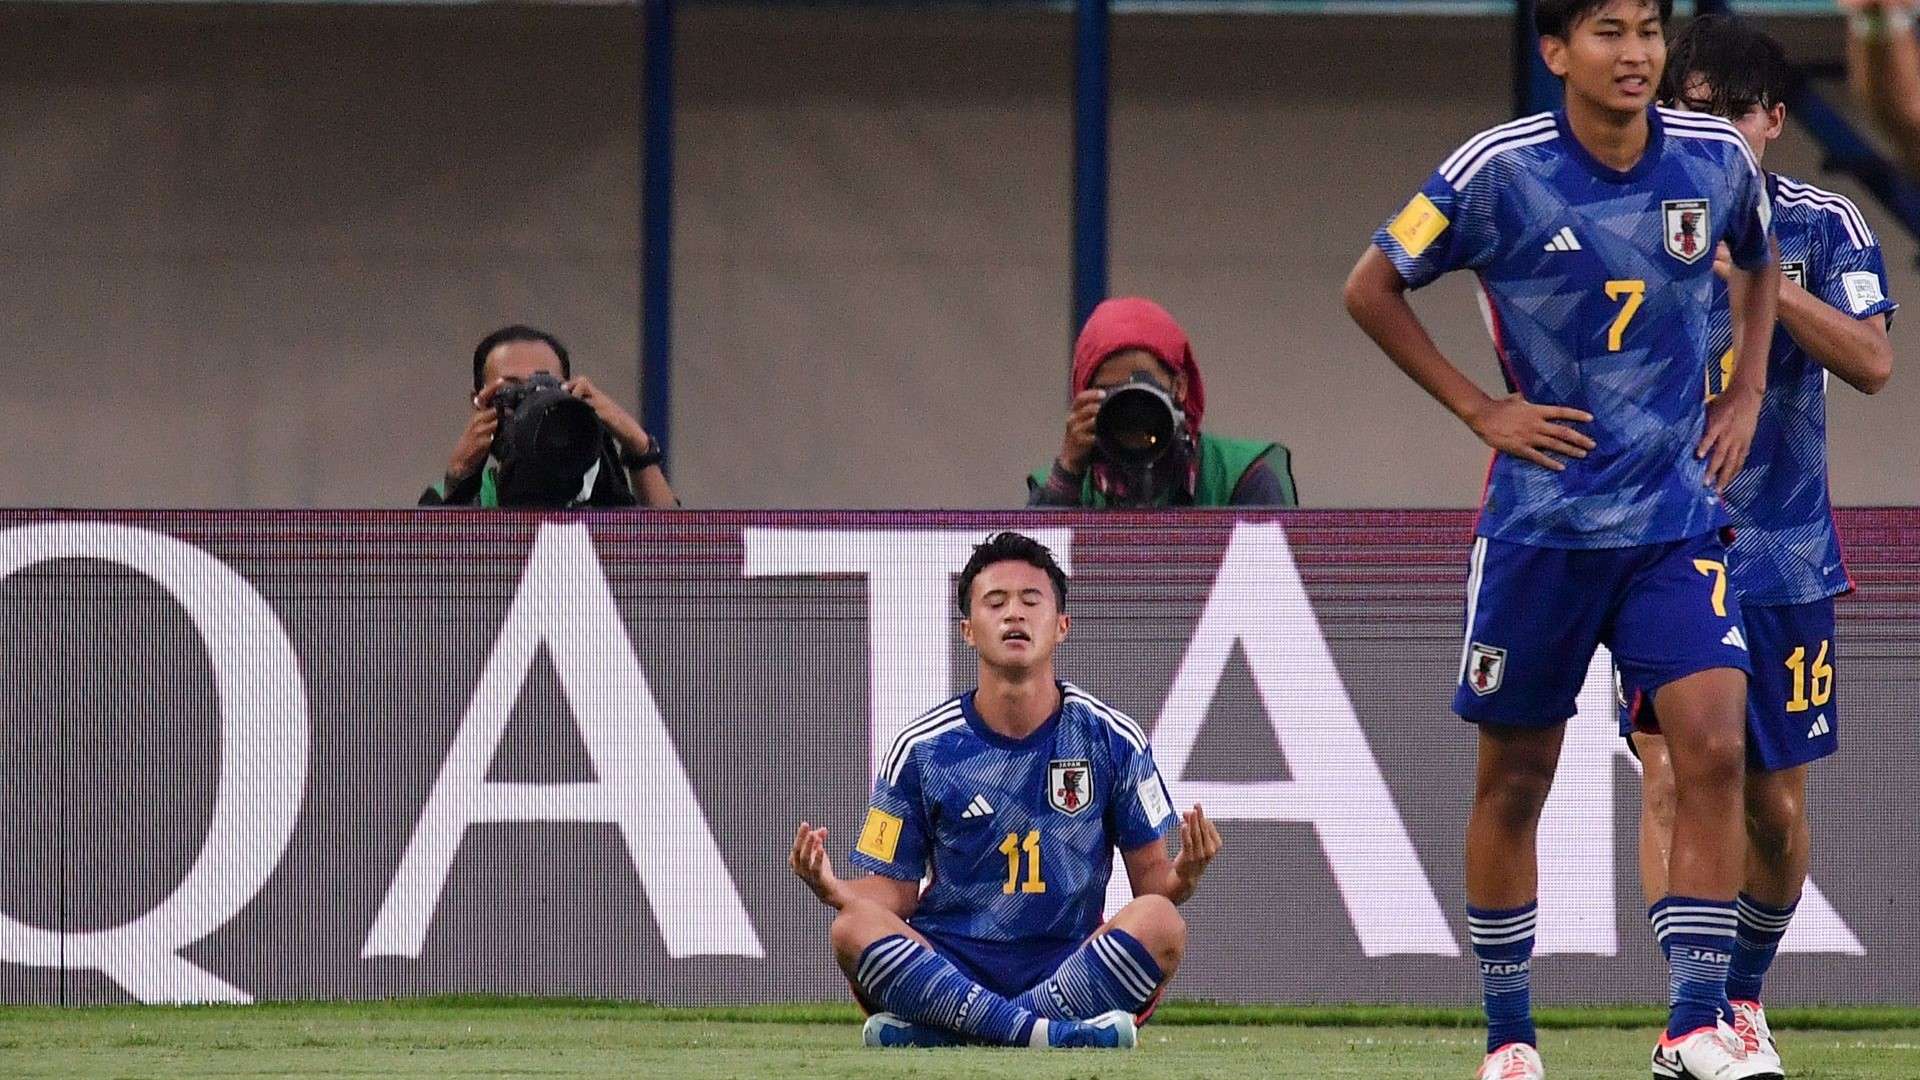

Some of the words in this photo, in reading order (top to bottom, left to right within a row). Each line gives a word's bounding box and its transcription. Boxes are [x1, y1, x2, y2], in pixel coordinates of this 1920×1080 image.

[1604, 280, 1645, 351] 7
[1693, 559, 1728, 617] 7
[1784, 640, 1833, 712] 16
[999, 830, 1046, 895] 11
